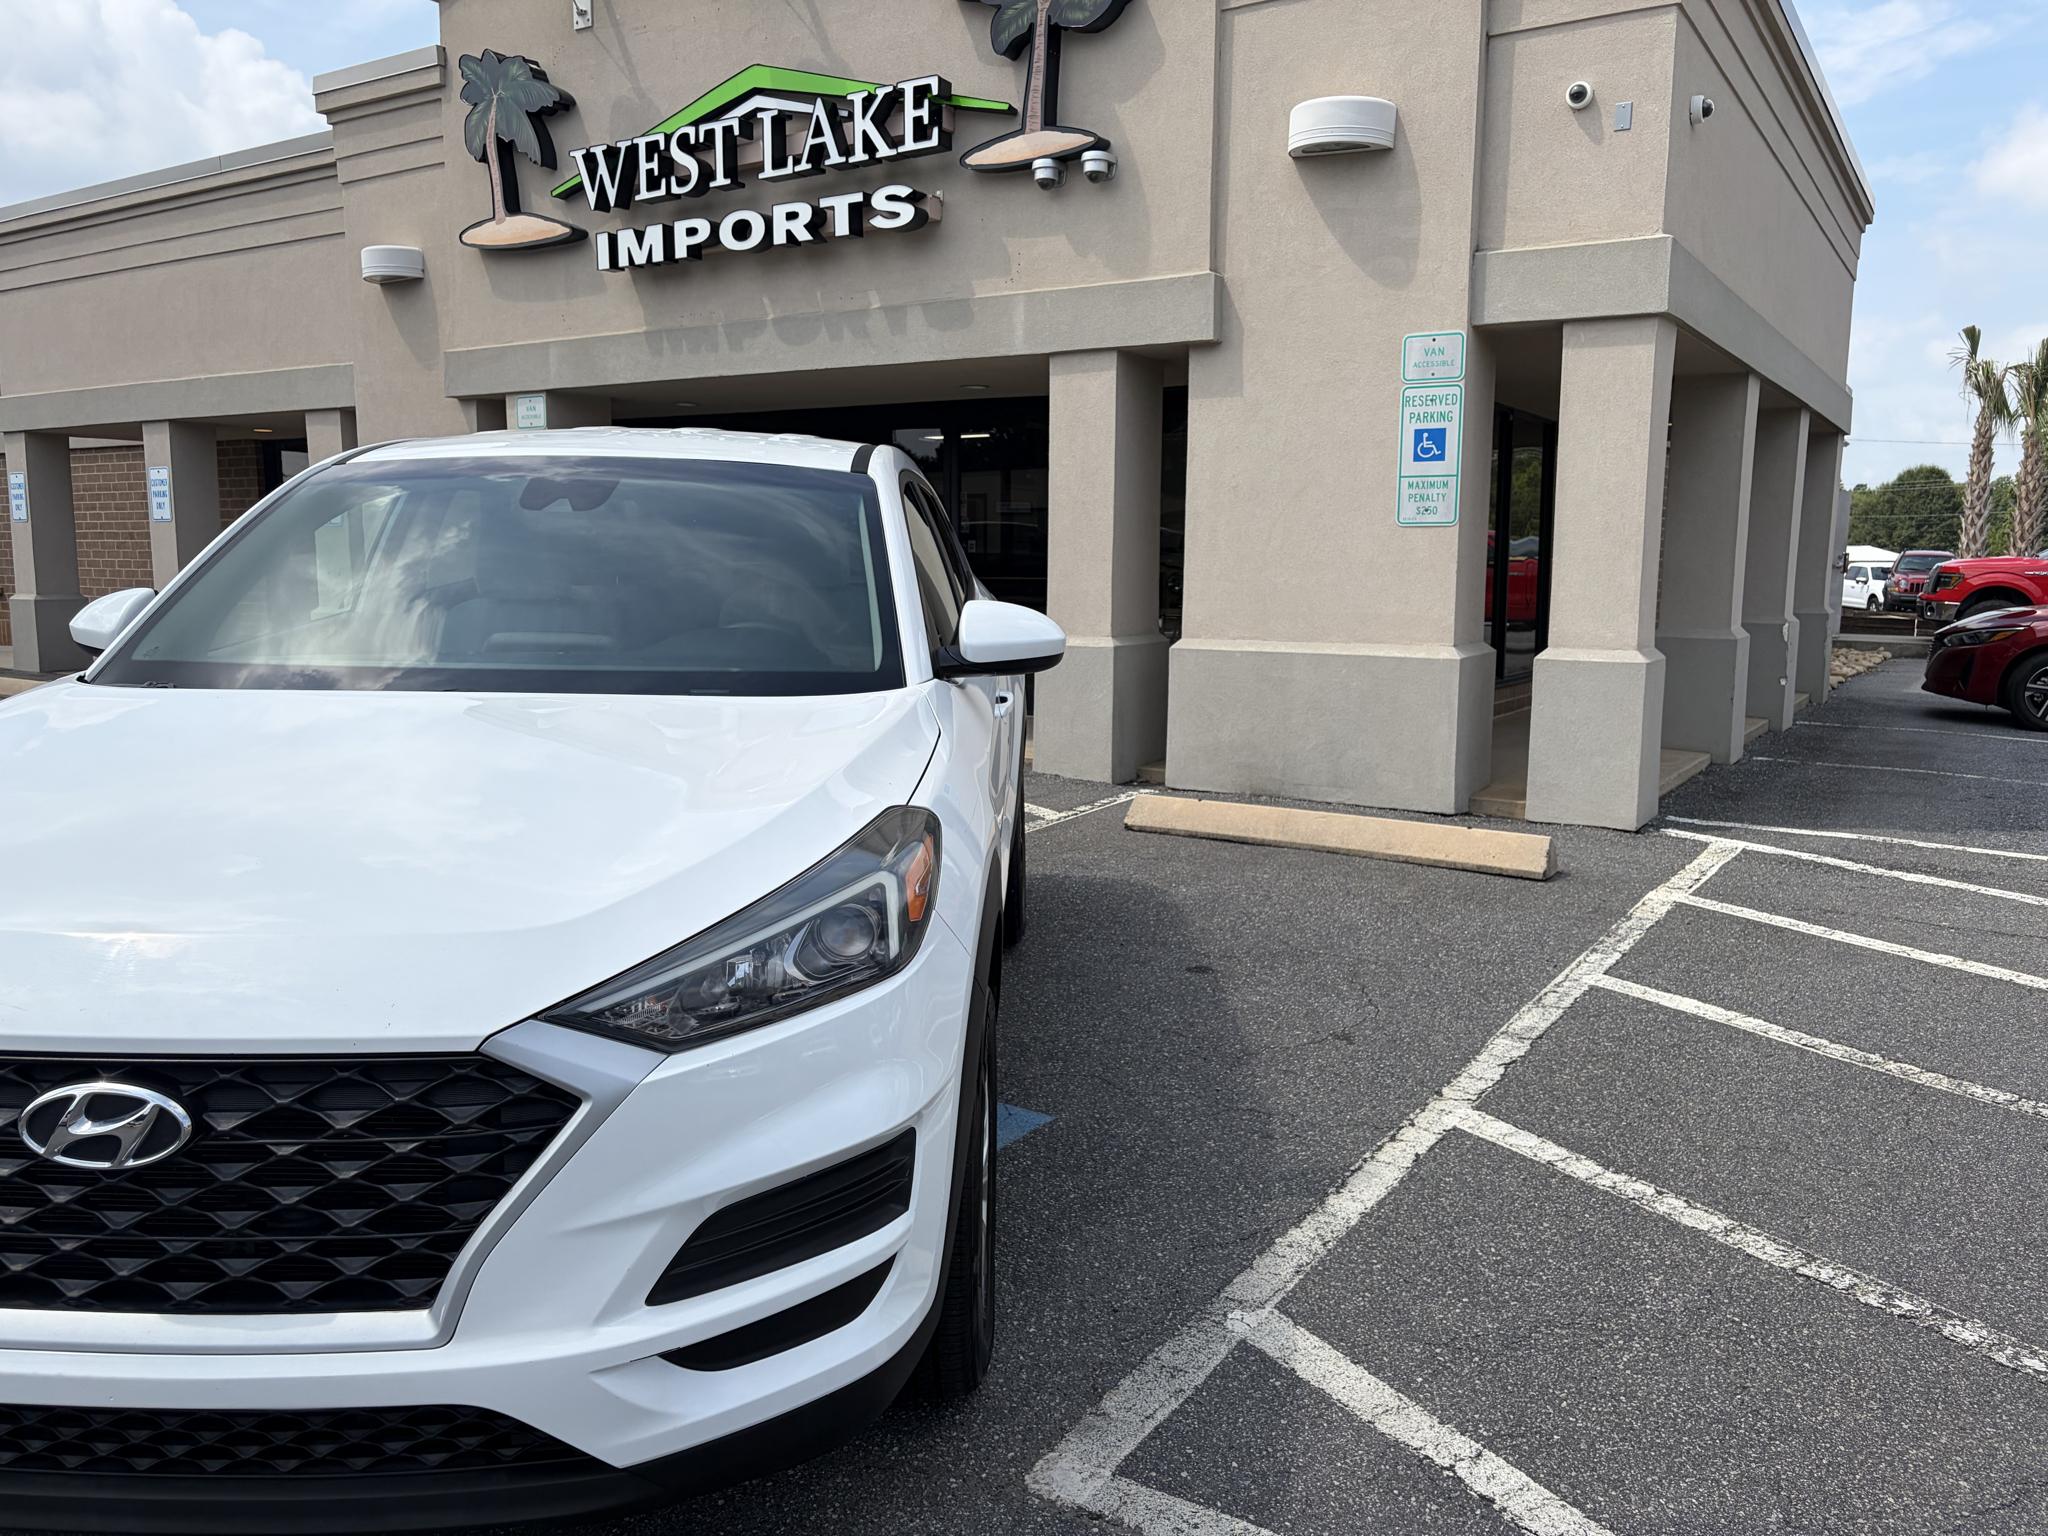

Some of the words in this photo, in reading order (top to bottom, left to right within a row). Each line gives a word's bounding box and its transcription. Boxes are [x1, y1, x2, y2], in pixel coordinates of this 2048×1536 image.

[569, 117, 740, 212] WEST
[757, 74, 940, 181] LAKE
[596, 184, 916, 271] IMPORTS
[1424, 346, 1445, 357] VAN
[1412, 360, 1455, 369] ACCESSIBLE
[1404, 393, 1458, 408] RESERVED
[1409, 410, 1453, 424] PARKING
[1407, 480, 1449, 490] MAXIMUM
[1408, 493, 1447, 503] PENALTY
